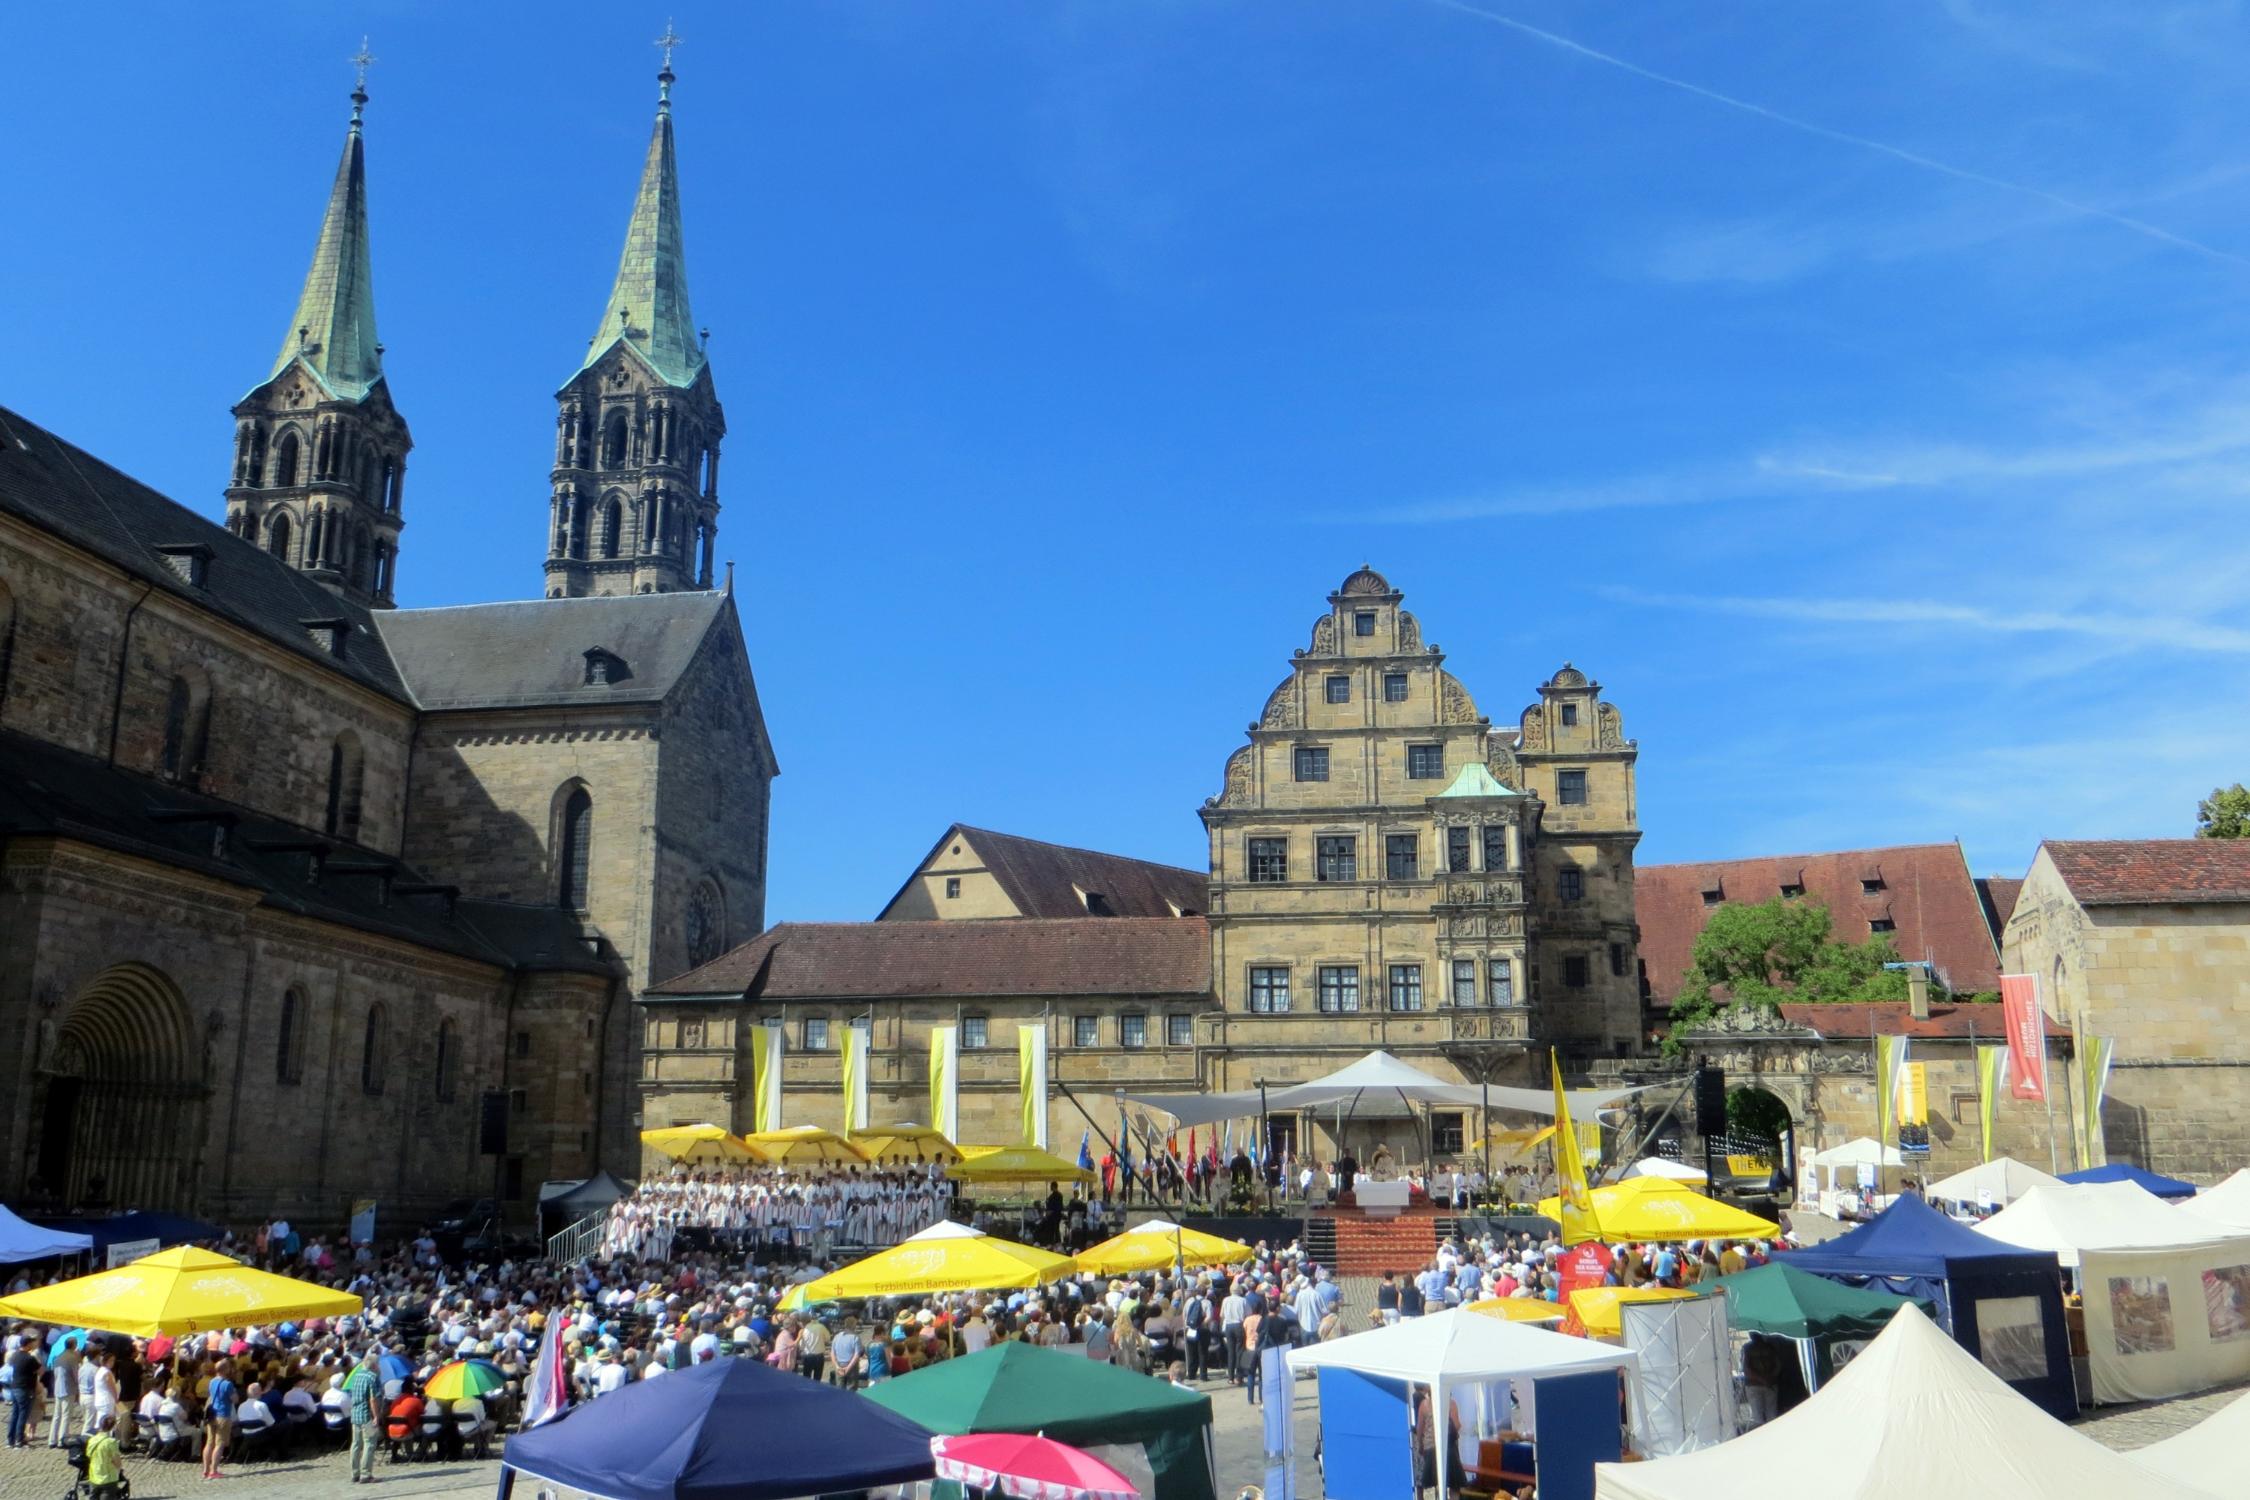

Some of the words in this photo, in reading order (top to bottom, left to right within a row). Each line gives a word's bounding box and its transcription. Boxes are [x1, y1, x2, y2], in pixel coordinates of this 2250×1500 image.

[874, 1281, 924, 1292] Erzbistum
[926, 1278, 971, 1289] Bamberg
[223, 1311, 268, 1325] Erzbistum
[270, 1308, 310, 1320] Bamberg
